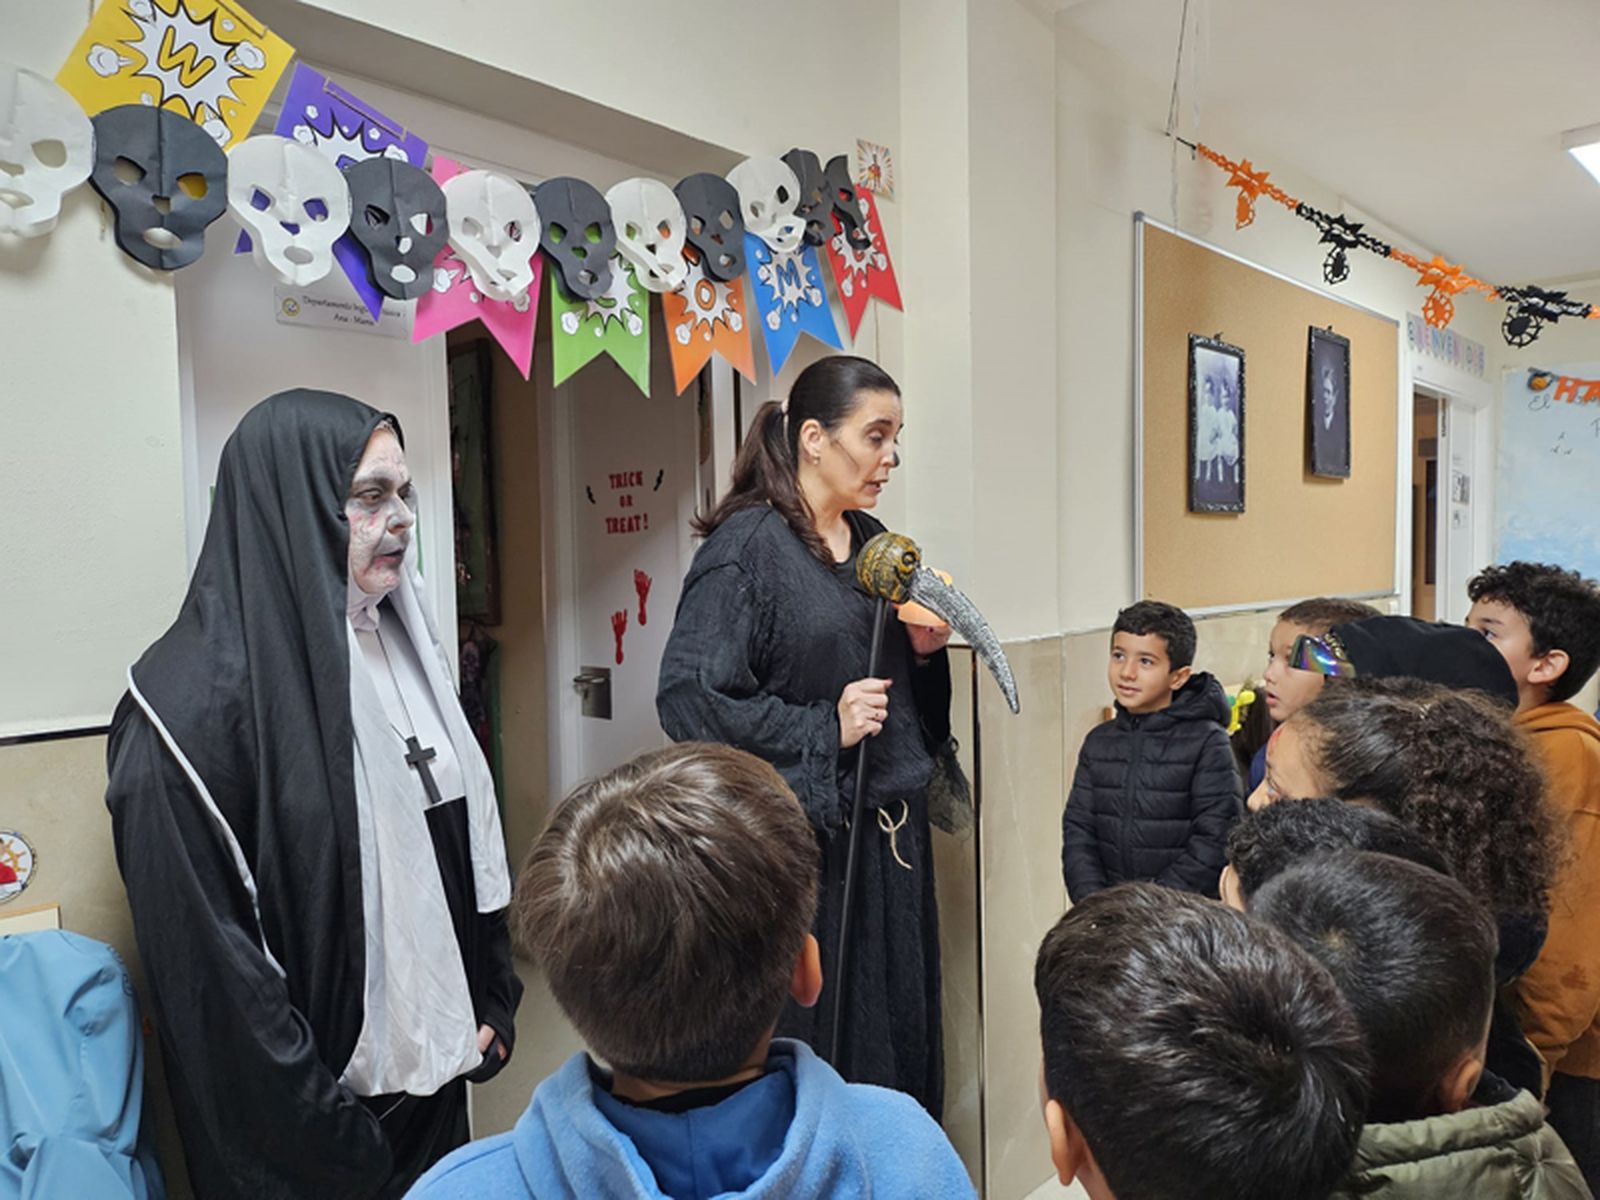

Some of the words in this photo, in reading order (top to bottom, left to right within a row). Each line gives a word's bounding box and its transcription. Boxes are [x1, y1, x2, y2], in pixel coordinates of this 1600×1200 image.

[609, 471, 643, 489] TRICK
[619, 494, 633, 507] OR
[605, 513, 649, 534] TREAT!
